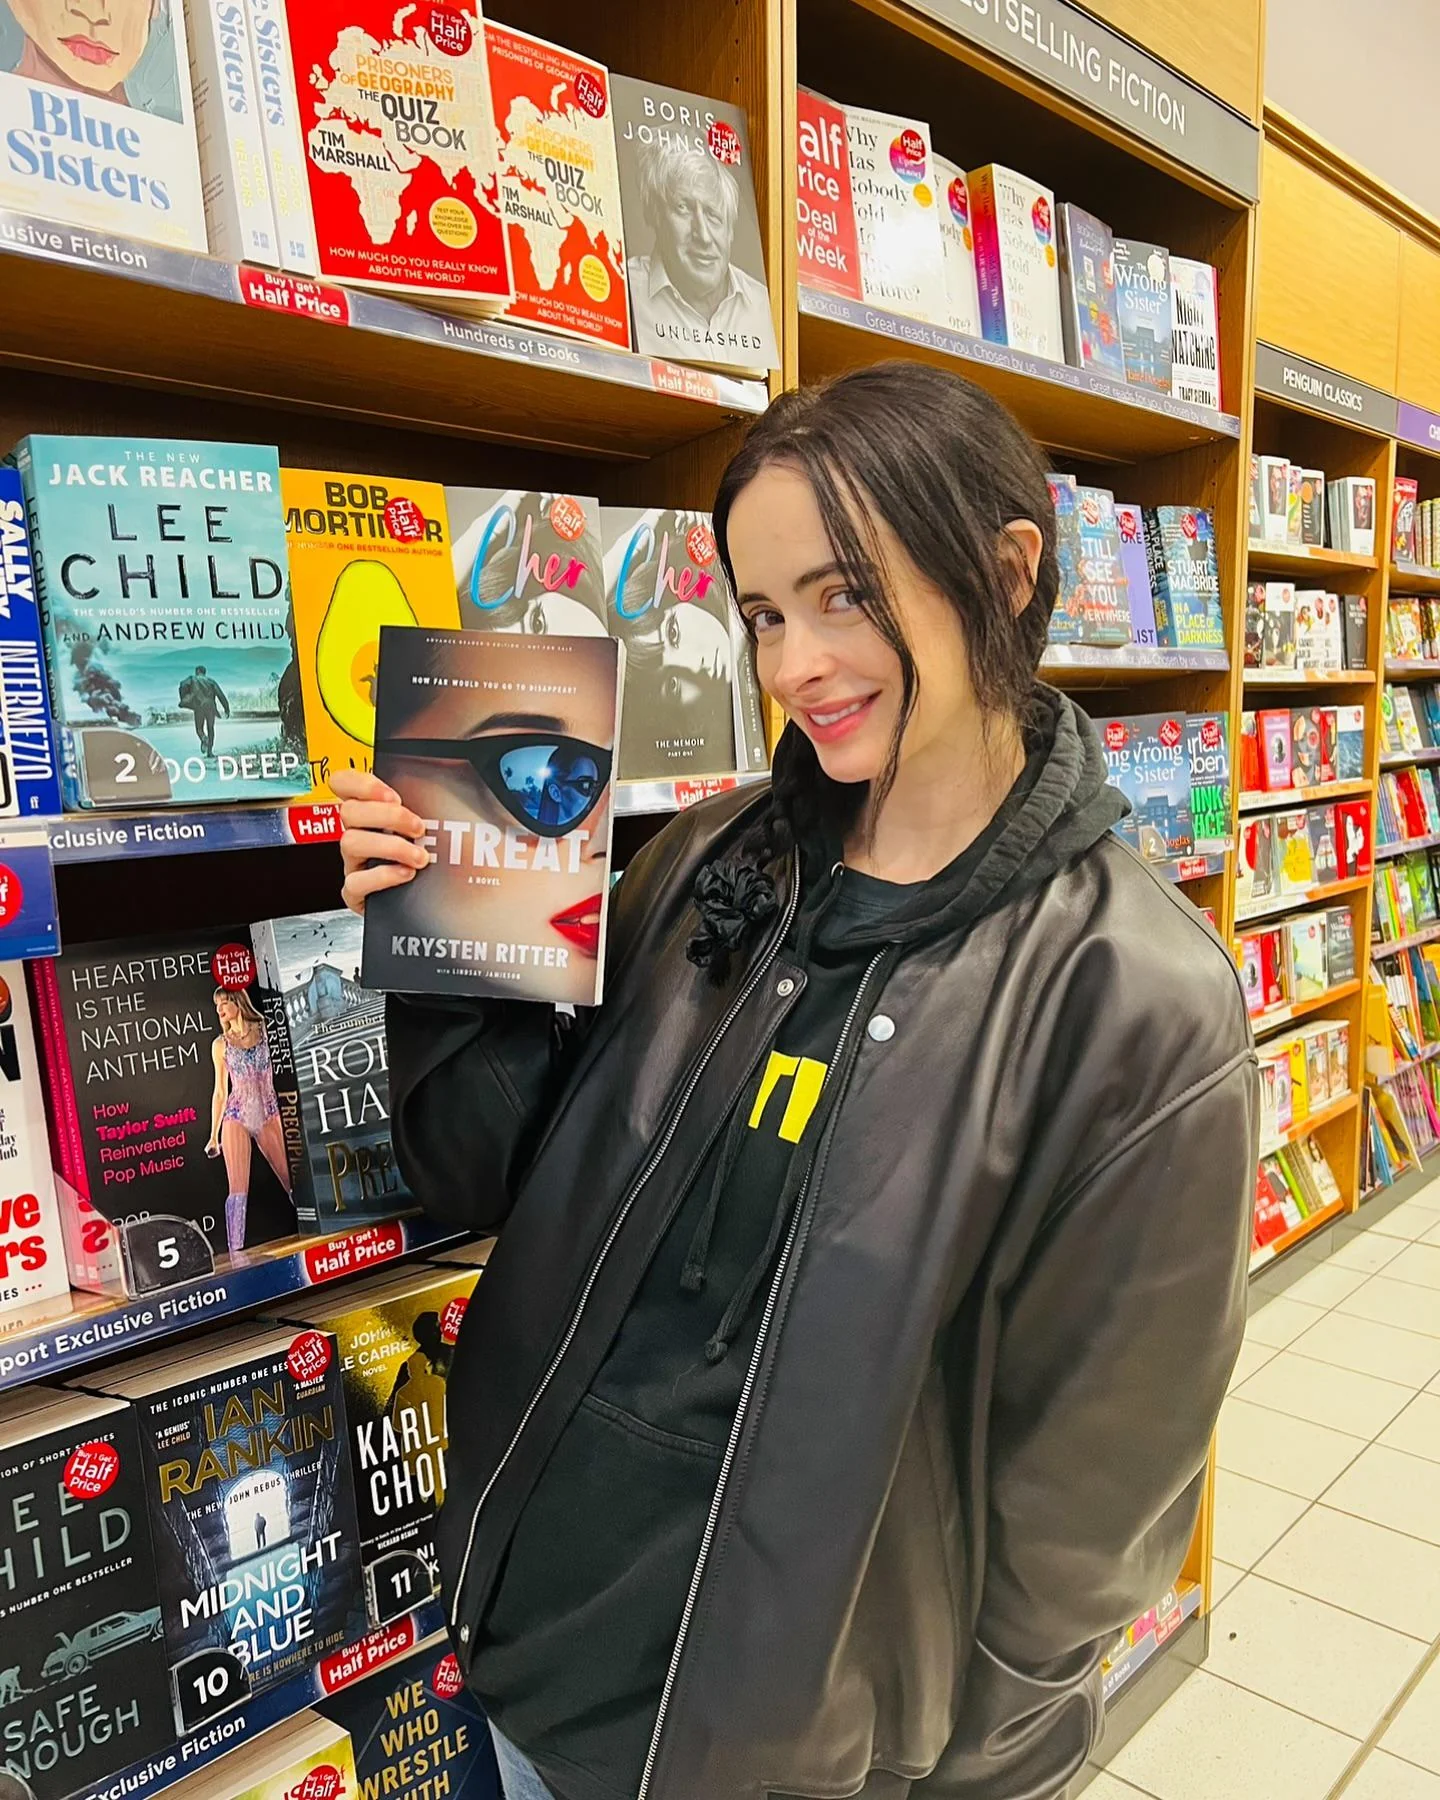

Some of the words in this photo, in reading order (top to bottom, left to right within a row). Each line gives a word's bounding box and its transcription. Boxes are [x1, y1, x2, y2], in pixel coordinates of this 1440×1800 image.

[216, 2, 249, 114] Sisters
[356, 54, 453, 84] PRISONERS
[959, 0, 1101, 82] STSELLING
[1109, 59, 1186, 136] FICTION
[358, 71, 455, 102] GEOGRAPHY
[28, 88, 140, 157] Blue
[358, 89, 380, 103] THE
[381, 94, 440, 125] QUIZ
[644, 97, 716, 130] BORIS
[318, 130, 345, 148] TIM
[395, 120, 466, 151] BOOK
[799, 118, 842, 171] alf
[6, 129, 171, 211] Sisters
[311, 145, 391, 172] MARSHALL
[796, 198, 838, 236] Deal
[70, 235, 148, 269] Fiction
[329, 246, 355, 259] HOW
[357, 252, 389, 265] MUCH
[391, 254, 406, 266] DO
[408, 257, 430, 269] YOU
[432, 259, 466, 272] REALLY
[468, 263, 498, 276] KNOW
[796, 236, 849, 274] Week
[368, 265, 402, 277] ABOUT
[404, 269, 423, 280] THE
[424, 271, 465, 284] WORLD?
[1114, 264, 1169, 301] Wrong
[249, 283, 290, 307] Half
[295, 294, 341, 318] Price
[1124, 292, 1162, 315] Sister
[443, 321, 515, 350] Hundreds
[519, 338, 535, 354] of
[538, 344, 580, 364] Books
[655, 323, 762, 350] UNLEASHED
[864, 311, 897, 334] Great
[899, 322, 931, 344] reads
[932, 331, 949, 348] for
[950, 338, 971, 357] you.
[972, 343, 1011, 366] Chosen
[1011, 353, 1025, 371] by
[1178, 386, 1194, 402] TRACY
[1283, 367, 1322, 398] PENGUIN
[1323, 384, 1363, 412] CLASSICS
[124, 451, 156, 462] THE
[167, 452, 200, 463] NEW
[48, 463, 130, 487] JACK
[140, 466, 273, 493] REACHER
[325, 481, 389, 511] BOB
[107, 503, 233, 544] LEE
[284, 507, 444, 543] MORTIR
[1, 499, 34, 603] SALLY
[471, 504, 588, 611] Cher
[1167, 559, 1208, 577] STUART
[60, 553, 283, 601] CHILD
[1084, 560, 1113, 583] SEE
[1169, 575, 1220, 592] MACBRIDE
[74, 608, 94, 617] THE
[99, 607, 147, 617] WORLD'S
[150, 607, 193, 617] NUMBER
[197, 607, 217, 616] ONE
[220, 607, 281, 616] BESTSELLER
[1088, 584, 1118, 606] YOU
[1182, 605, 1190, 614] A
[63, 632, 90, 643] AND
[97, 621, 205, 641] ANDREW
[216, 621, 286, 641] CHILD
[1176, 612, 1206, 629] PLACE
[1178, 629, 1224, 645] DARKNESS
[412, 676, 431, 685] HOW
[433, 678, 449, 686] FAR
[452, 679, 479, 688] WOULD
[528, 684, 577, 695] DISAPPEAR?
[1, 640, 53, 782] INTERMEZZO
[655, 739, 671, 748] THE
[673, 738, 705, 748] MEMOIR
[114, 753, 139, 784] 2
[217, 752, 300, 782] DEEP
[1134, 766, 1176, 785] Sister
[134, 823, 205, 844] Fiction
[297, 816, 336, 836] Half
[1149, 837, 1157, 852] 2
[468, 876, 474, 884] A
[476, 877, 500, 887] NOVEL
[217, 956, 251, 976] Half
[391, 935, 488, 963] KRYSTEN
[496, 943, 570, 969] RITTER
[71, 952, 210, 993] HEARTBRE
[223, 973, 250, 987] Price
[451, 967, 484, 978] LINDSAY
[484, 970, 522, 981] JAMIESON
[76, 1000, 98, 1020] IS
[101, 992, 146, 1016] THE
[80, 1010, 213, 1053] NATIONAL
[262, 997, 284, 1075] HARRIS
[272, 996, 295, 1075] ROBERT
[86, 1042, 200, 1085] ANTHEM
[93, 1102, 130, 1120] How
[96, 1118, 149, 1142] Taylor
[153, 1106, 197, 1130] Swift
[100, 1131, 187, 1164] Reinvented
[103, 1164, 136, 1186] Pop
[140, 1153, 185, 1177] Music
[157, 1237, 180, 1269] 5
[314, 1252, 350, 1275] Half
[355, 1237, 396, 1261] Price
[55, 1310, 154, 1354] Exclusive
[159, 1286, 228, 1321] Fiction
[362, 1363, 388, 1378] NOVEL
[150, 1402, 169, 1416] THE
[173, 1388, 207, 1409] ICONIC
[210, 1373, 249, 1395] NUMBER
[251, 1367, 269, 1382] ONE
[203, 1379, 286, 1443] IAN
[157, 1438, 171, 1450] LEE
[171, 1431, 192, 1445] CHILD
[158, 1404, 336, 1505] RANKIN
[186, 1507, 205, 1522] THE
[205, 1501, 226, 1517] NEW
[229, 1488, 251, 1506] JOHN
[253, 1478, 283, 1498] REBUS
[284, 1461, 323, 1482] THRILLER
[9, 1592, 50, 1615] NUMBER
[52, 1582, 73, 1597] ONE
[75, 1557, 133, 1588] BESTSELLER
[179, 1530, 342, 1630] MIDNIGHT
[390, 1568, 412, 1599] 11
[229, 1583, 307, 1640] AND
[227, 1607, 316, 1668] BLUE
[273, 1650, 312, 1673] NOWHERE
[314, 1640, 326, 1652] TO
[326, 1630, 345, 1648] HIDE
[329, 1652, 363, 1685] Half
[367, 1630, 408, 1662] Price
[192, 1666, 229, 1705] 10
[385, 1680, 427, 1720] WE
[3, 1684, 101, 1753] SAFE
[380, 1708, 439, 1757] WHO
[181, 1714, 247, 1762] Fiction
[357, 1725, 470, 1800] WRESTLE
